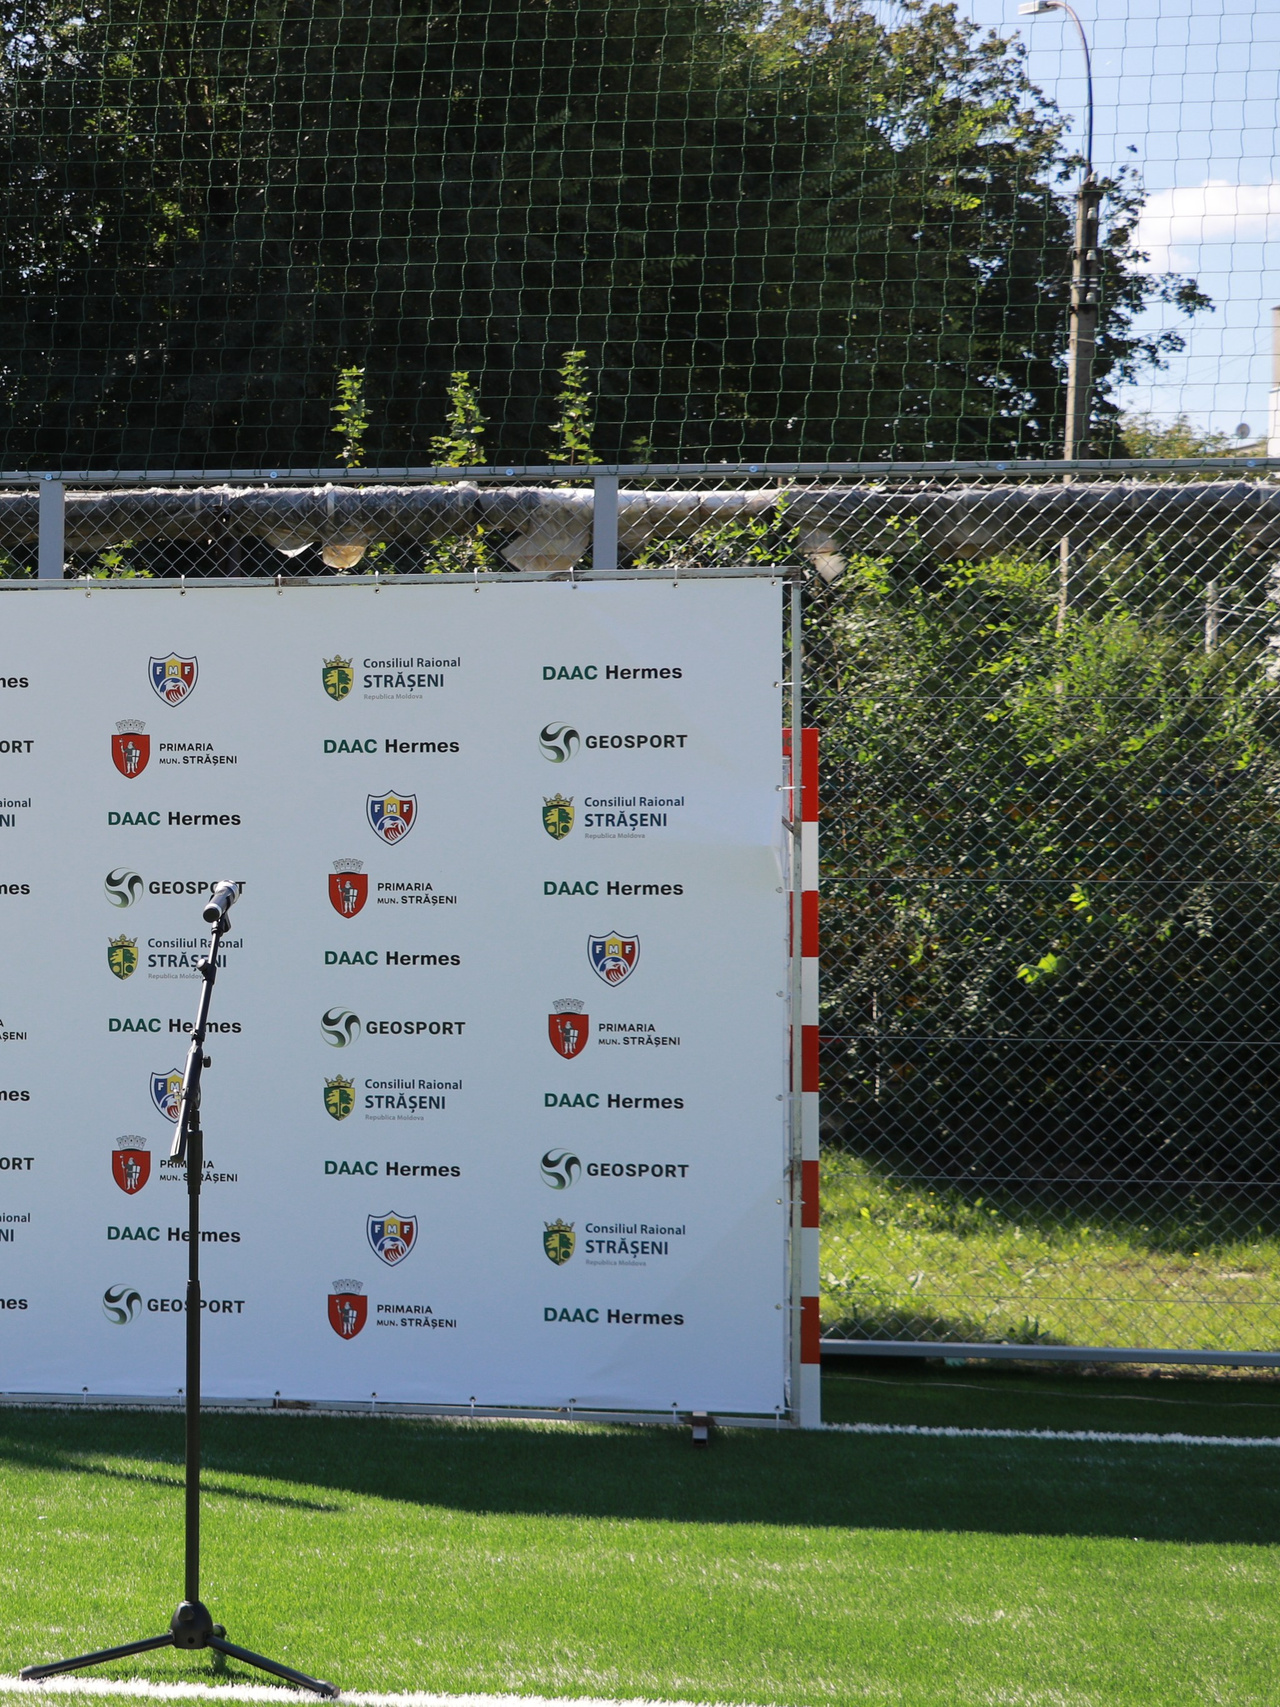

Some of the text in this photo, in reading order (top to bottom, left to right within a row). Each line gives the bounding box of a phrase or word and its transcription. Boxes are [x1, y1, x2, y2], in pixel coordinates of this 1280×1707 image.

[362, 656, 461, 669] Consiliul Raional
[542, 664, 683, 681] DAAC Hermes
[159, 742, 214, 752] PRIMARIA
[323, 738, 460, 754] DAAC Hermes
[584, 734, 689, 750] GEOSPORT
[158, 757, 181, 765] MUN.
[584, 795, 685, 808] Consiliul Raional
[107, 810, 242, 826] DAAC Hermes
[148, 881, 247, 895] GEOSPT
[377, 882, 434, 892] PRIMARIA
[543, 880, 684, 896] DAAC Hermes
[376, 897, 400, 905] MUN.
[147, 937, 244, 949] Consiliul Raonal
[324, 950, 461, 966] DAAC Hermes
[179, 972, 203, 980] Moldov
[108, 1017, 242, 1033] DAAC Hemes
[365, 1020, 467, 1036] GEOSPORT
[598, 1022, 656, 1033] PRIMARIA
[597, 1038, 621, 1046] MUN.
[364, 1078, 463, 1091] Consiliul Raional
[544, 1092, 685, 1110] DAAC Hermes
[159, 1159, 215, 1169] PRIMIA
[324, 1160, 461, 1178] DAAC Hermes
[585, 1162, 690, 1179] GEOSPORT
[107, 1225, 241, 1242] DAAC Hemes
[585, 1222, 686, 1236] Consiliul Raional
[147, 1298, 245, 1314] GEOPORT
[376, 1304, 433, 1315] PRIMARIA
[376, 1319, 399, 1327] MUN.
[543, 1306, 685, 1326] DAAC Hermes
